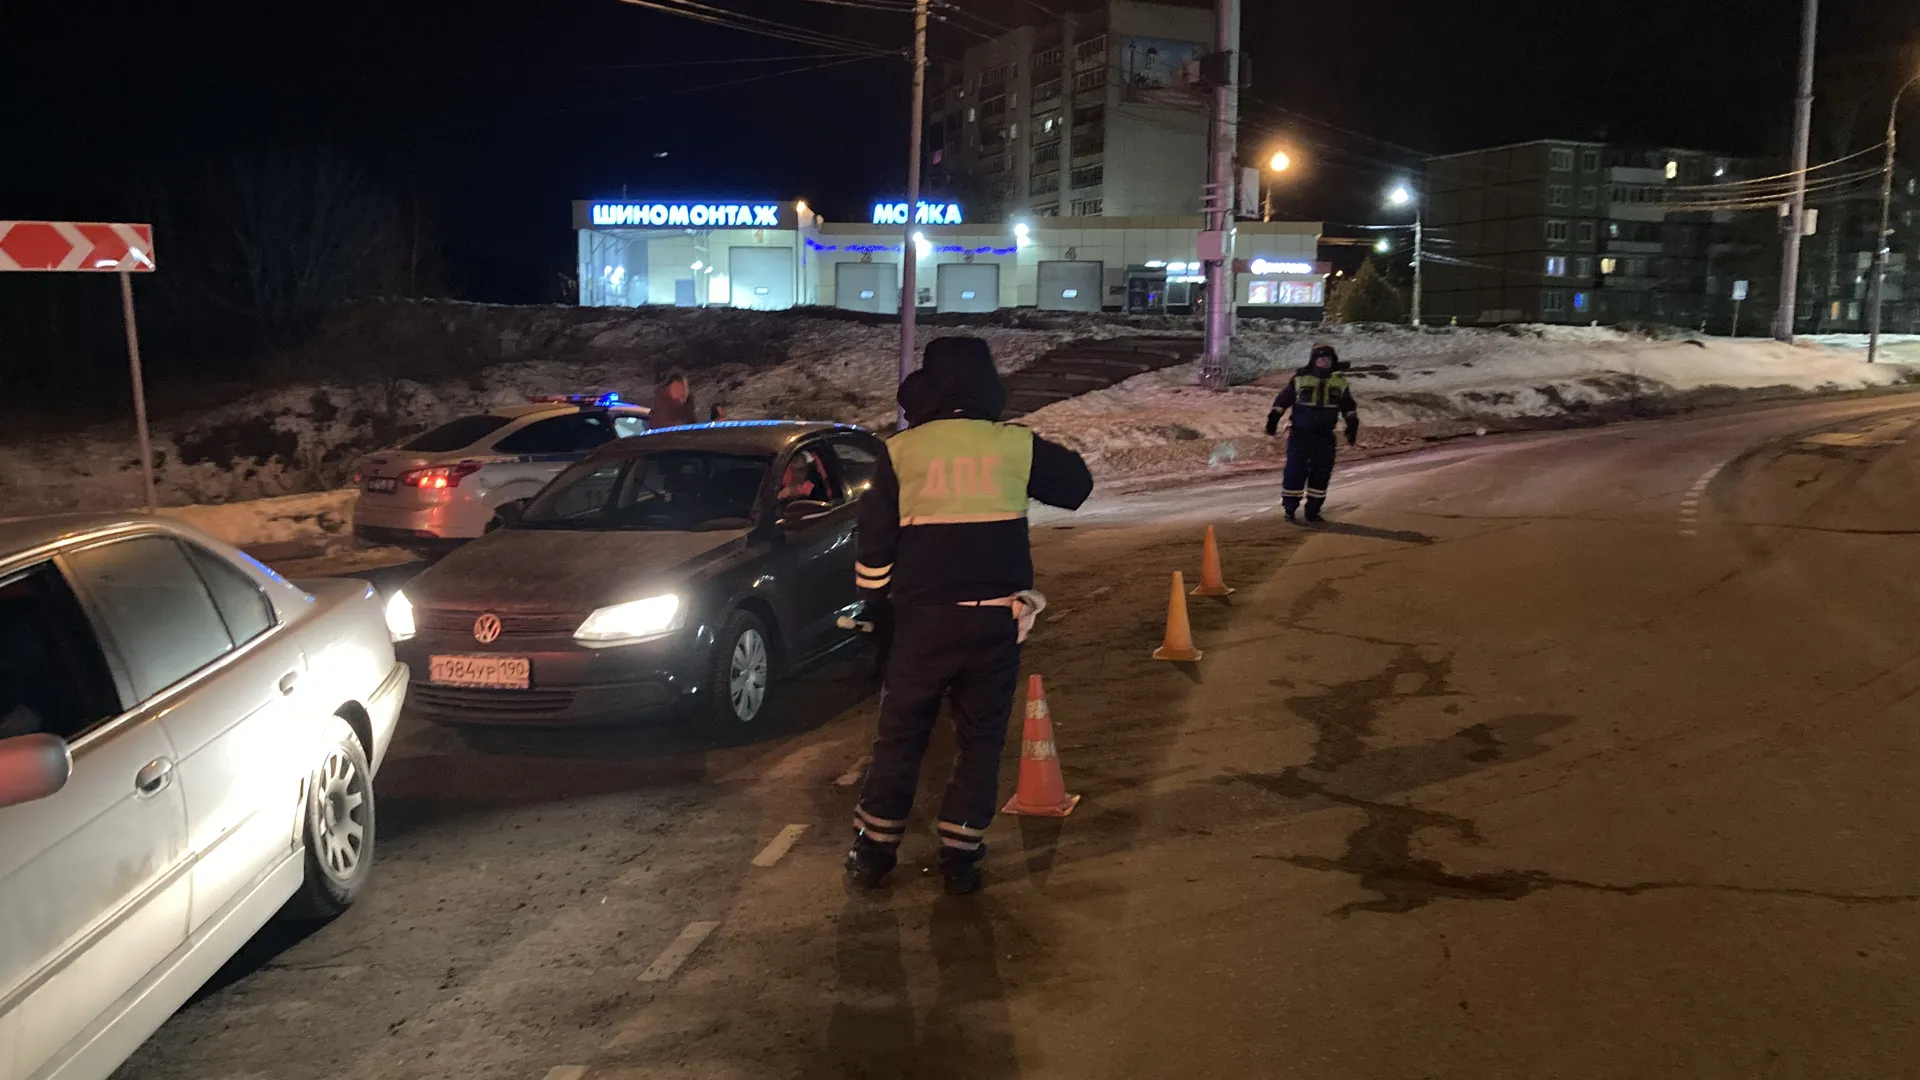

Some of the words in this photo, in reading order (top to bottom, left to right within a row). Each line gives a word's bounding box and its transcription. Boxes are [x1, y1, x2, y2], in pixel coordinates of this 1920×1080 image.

[593, 204, 778, 226] ШИНОМОНТАЖ
[922, 456, 1002, 497] ДПС
[500, 662, 525, 677] 190
